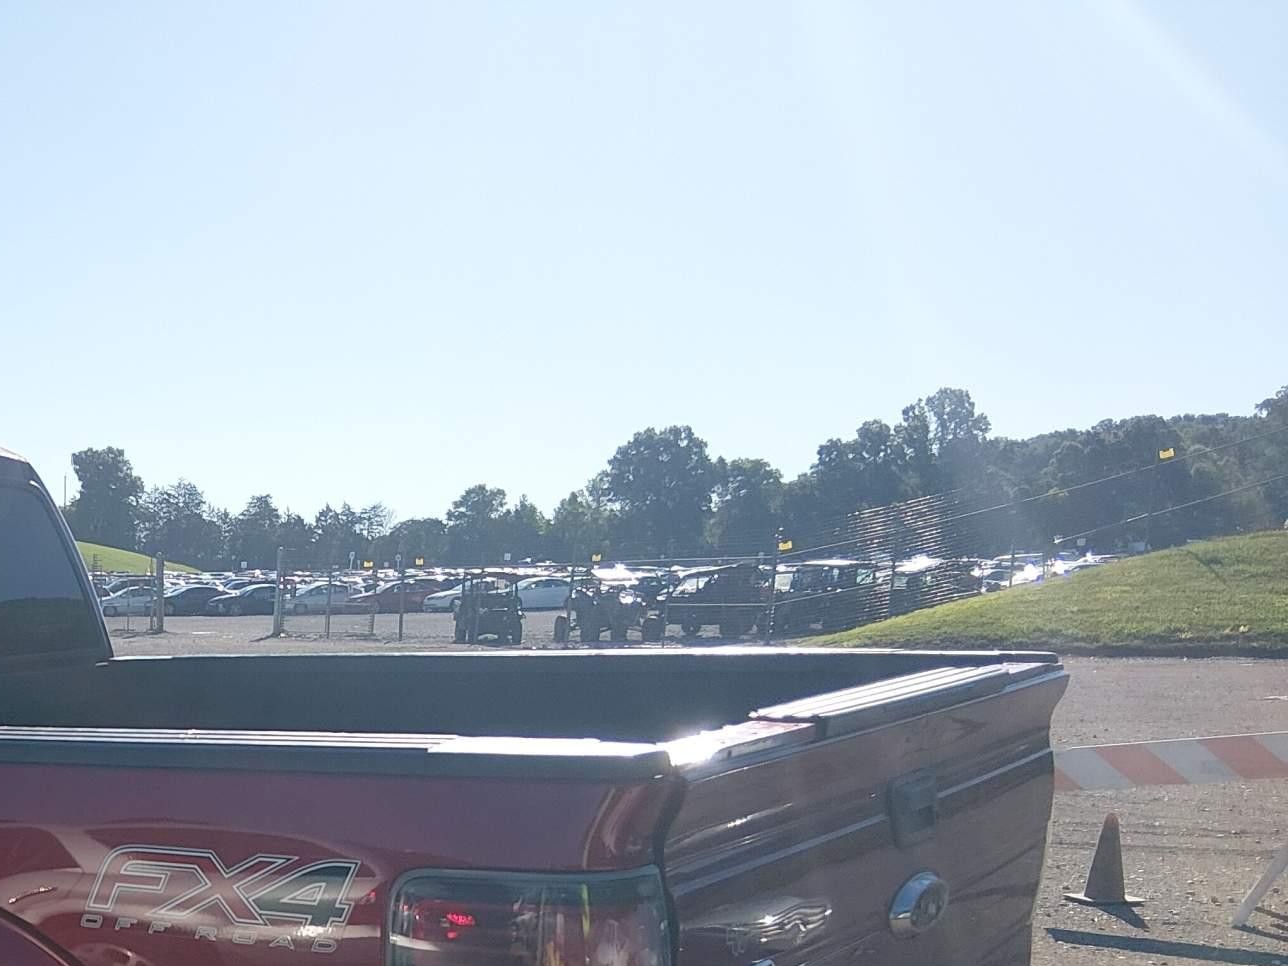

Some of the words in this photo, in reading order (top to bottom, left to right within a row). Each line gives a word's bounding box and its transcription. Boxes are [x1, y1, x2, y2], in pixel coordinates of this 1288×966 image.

[85, 844, 361, 928] FX4
[80, 914, 172, 934] OFF
[194, 926, 338, 953] ROAD
